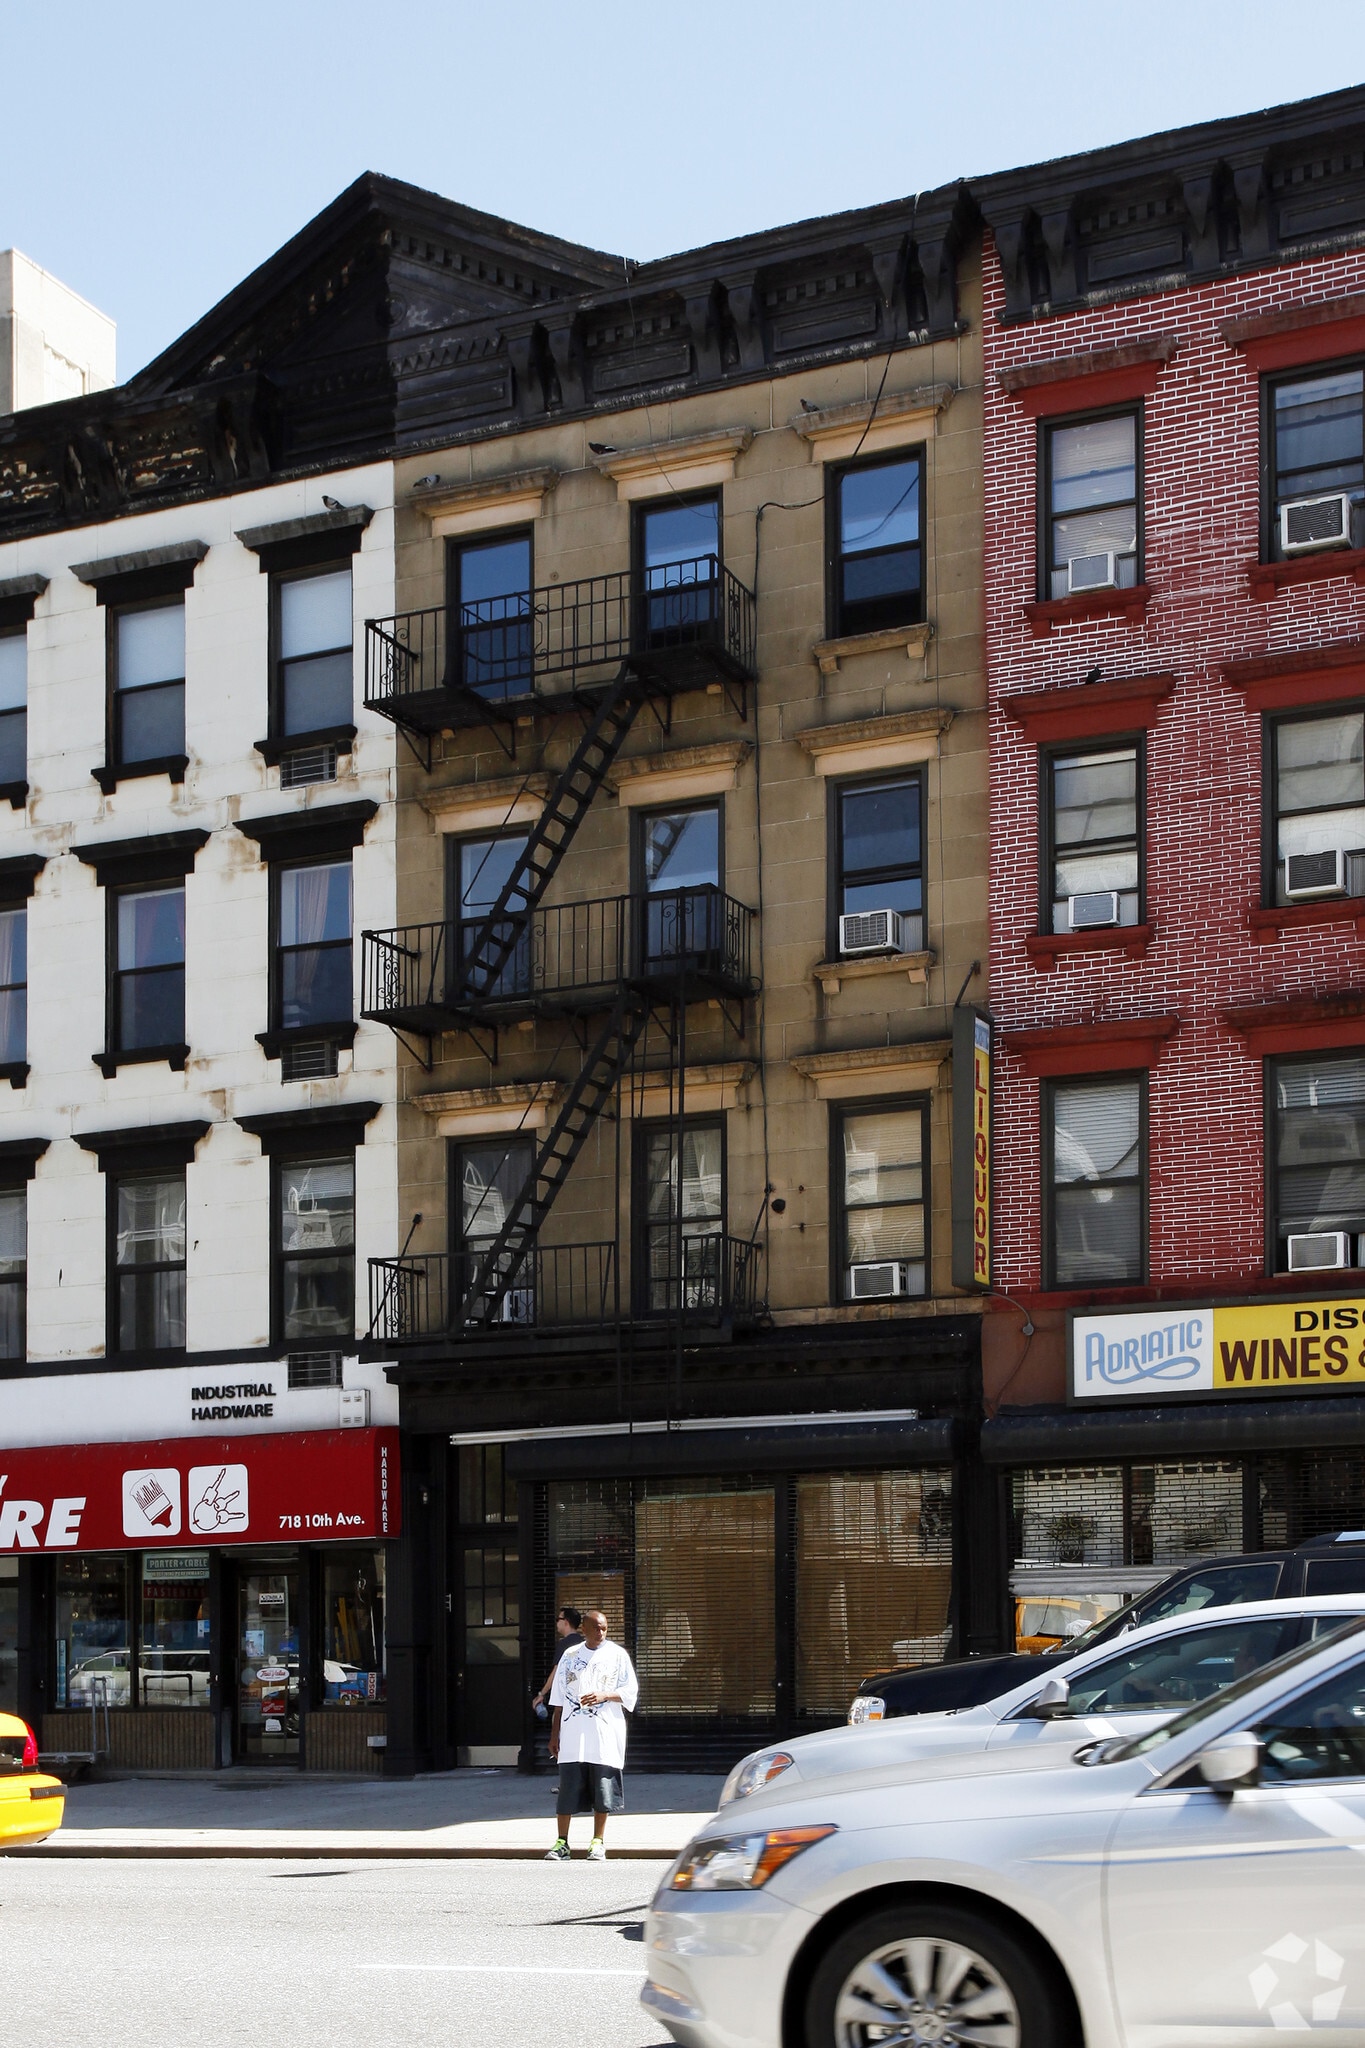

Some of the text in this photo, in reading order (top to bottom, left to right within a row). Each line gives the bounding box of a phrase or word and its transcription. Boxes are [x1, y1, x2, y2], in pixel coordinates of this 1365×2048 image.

[975, 1058, 987, 1276] LIQUOR
[1294, 1308, 1365, 1332] DIS
[1085, 1319, 1203, 1384] ADRIATIC
[1220, 1335, 1349, 1382] WINES
[191, 1383, 276, 1400] INDUSTRIAL
[191, 1403, 273, 1420] HARDWARE
[279, 1512, 365, 1529] 718 10th Ave.
[368, 1673, 376, 1700] BOSCH
